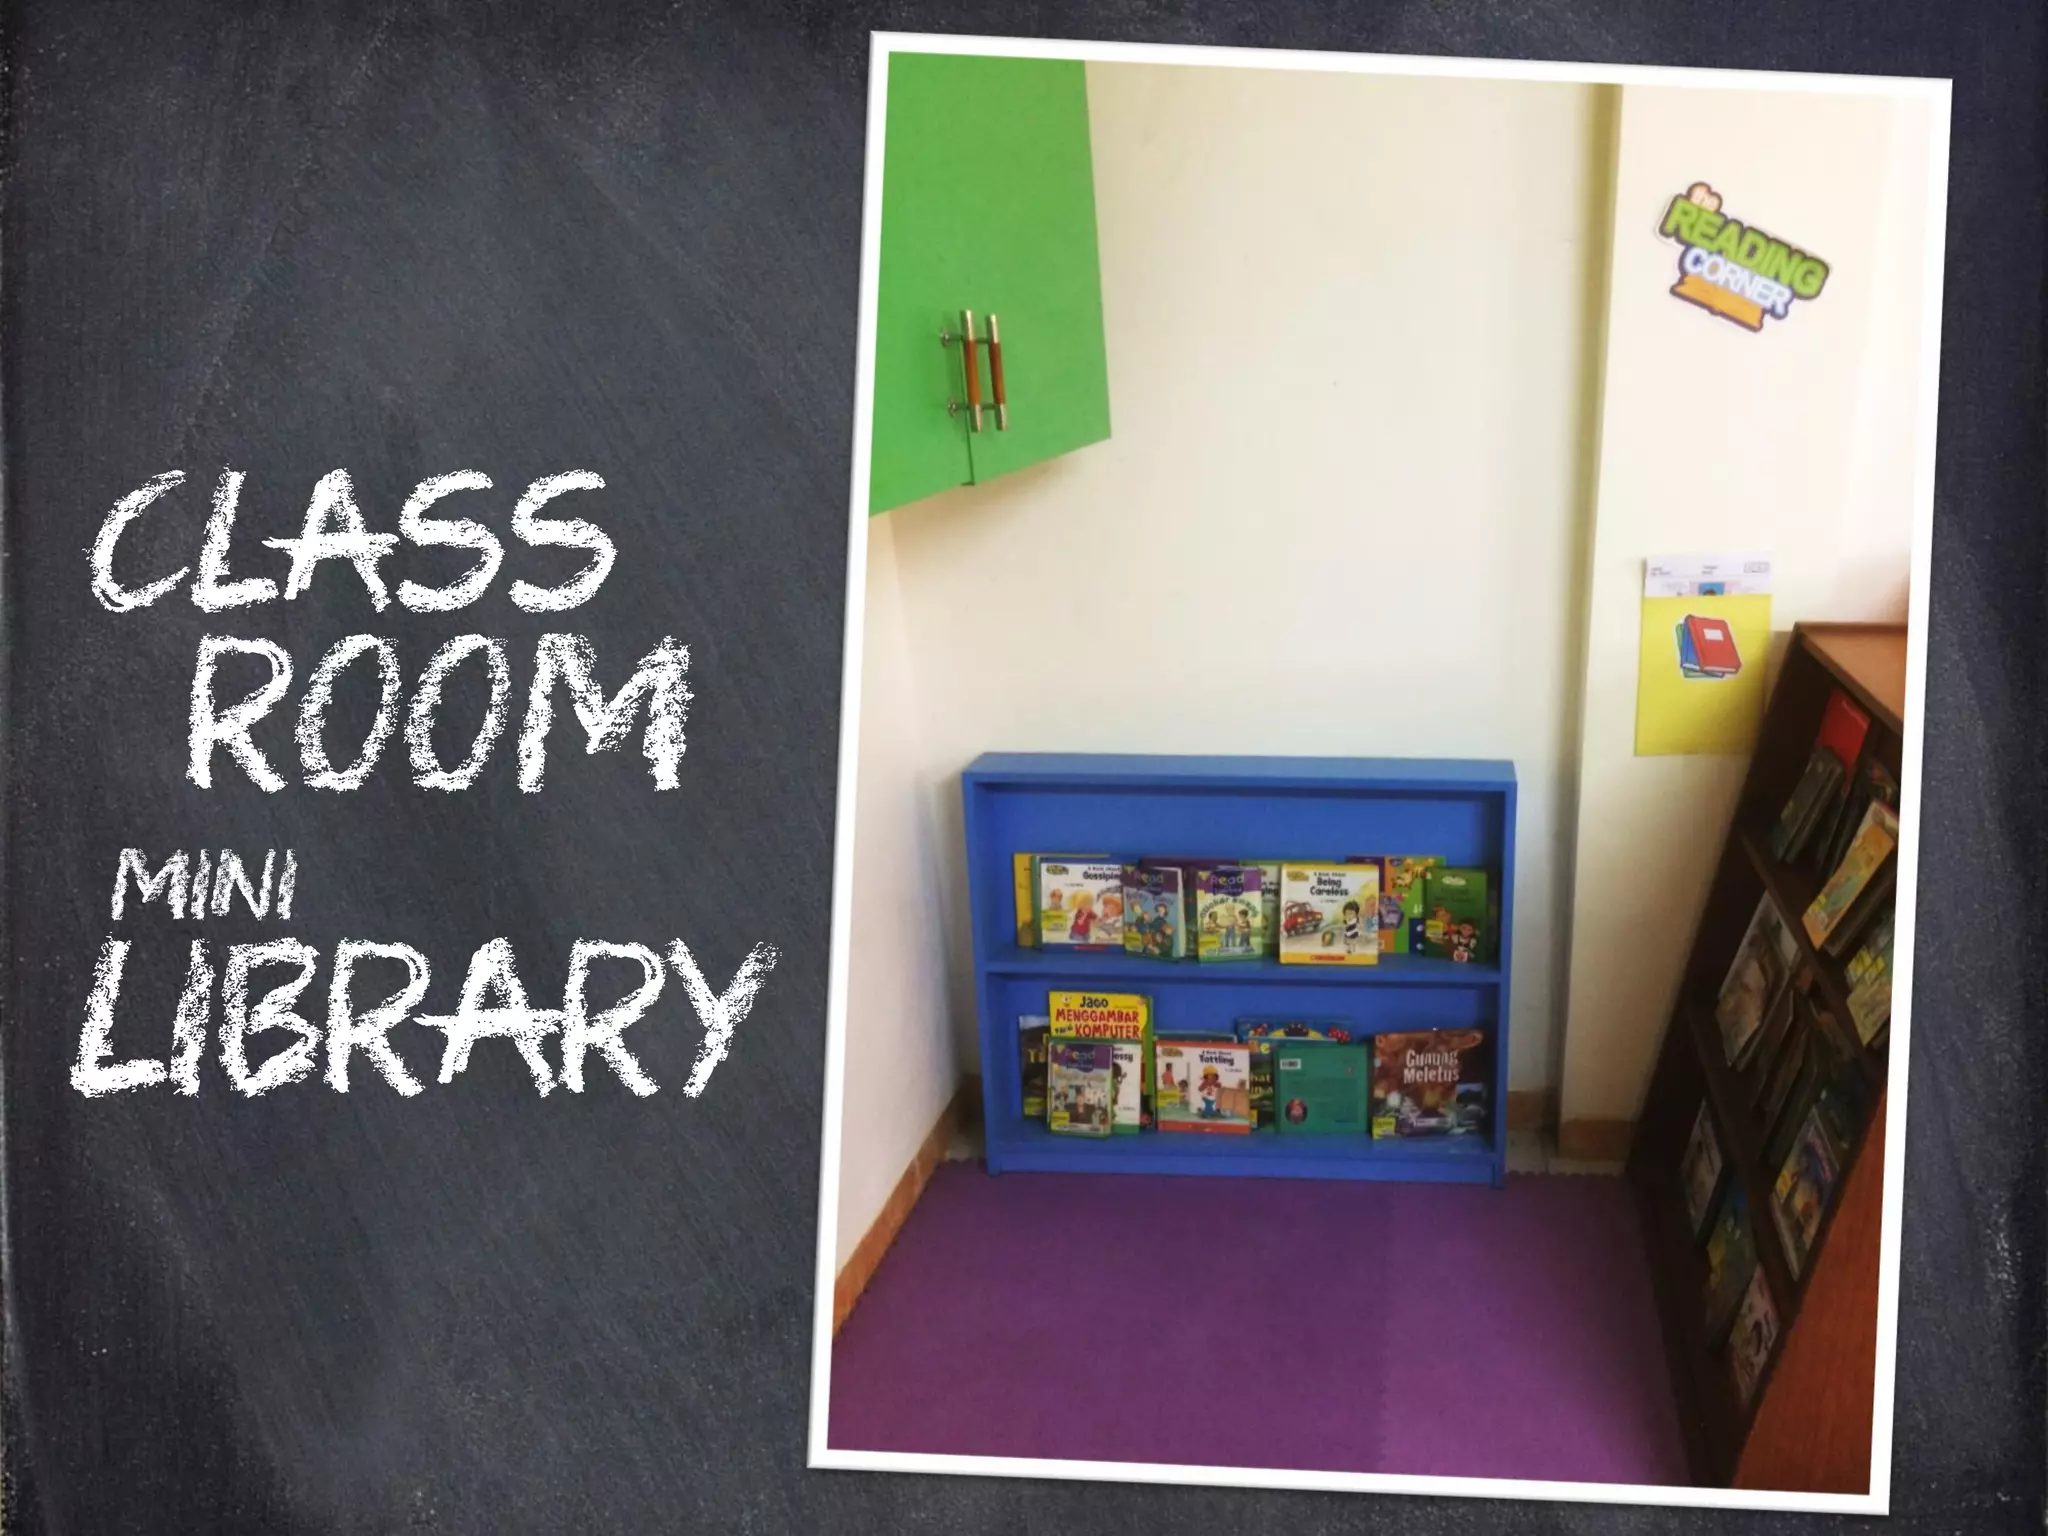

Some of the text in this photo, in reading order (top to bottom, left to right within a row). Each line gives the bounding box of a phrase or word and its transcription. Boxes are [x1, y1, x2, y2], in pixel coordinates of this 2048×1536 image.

[1660, 195, 1829, 300] READING
[1682, 245, 1793, 318] CORNER
[1210, 871, 1245, 886] Read
[1316, 876, 1342, 889] Being
[1309, 885, 1349, 896] Careless
[1055, 1007, 1140, 1023] MENGGAMBAR
[1074, 1023, 1140, 1039] KOMPUTER
[1198, 1053, 1235, 1066] Tattling
[1405, 1048, 1459, 1067] Gunung
[1403, 1064, 1460, 1084] Meletus
